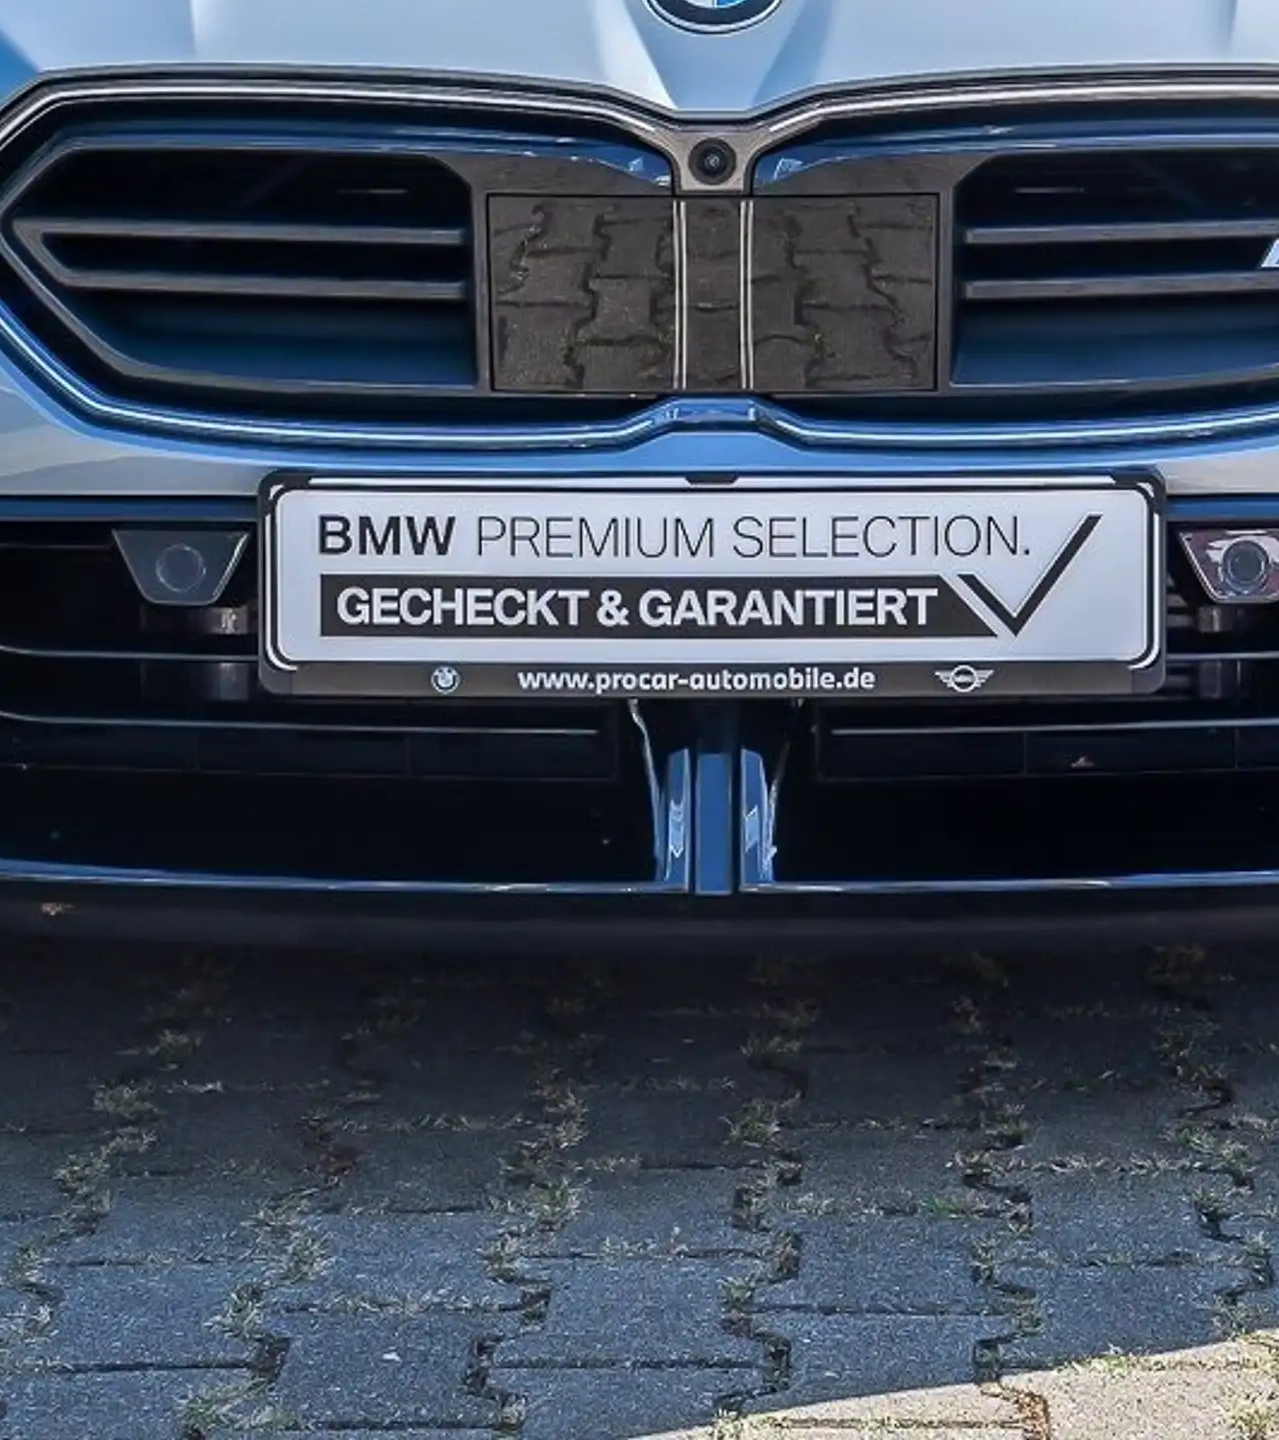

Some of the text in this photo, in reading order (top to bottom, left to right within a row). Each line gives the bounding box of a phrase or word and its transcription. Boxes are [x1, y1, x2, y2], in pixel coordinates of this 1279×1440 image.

[318, 515, 1031, 558] BMW PREMIUM SELECTION.
[336, 586, 939, 627] GECHECKT & GARANTIERT
[518, 667, 876, 695] www.procar-automobile.de
